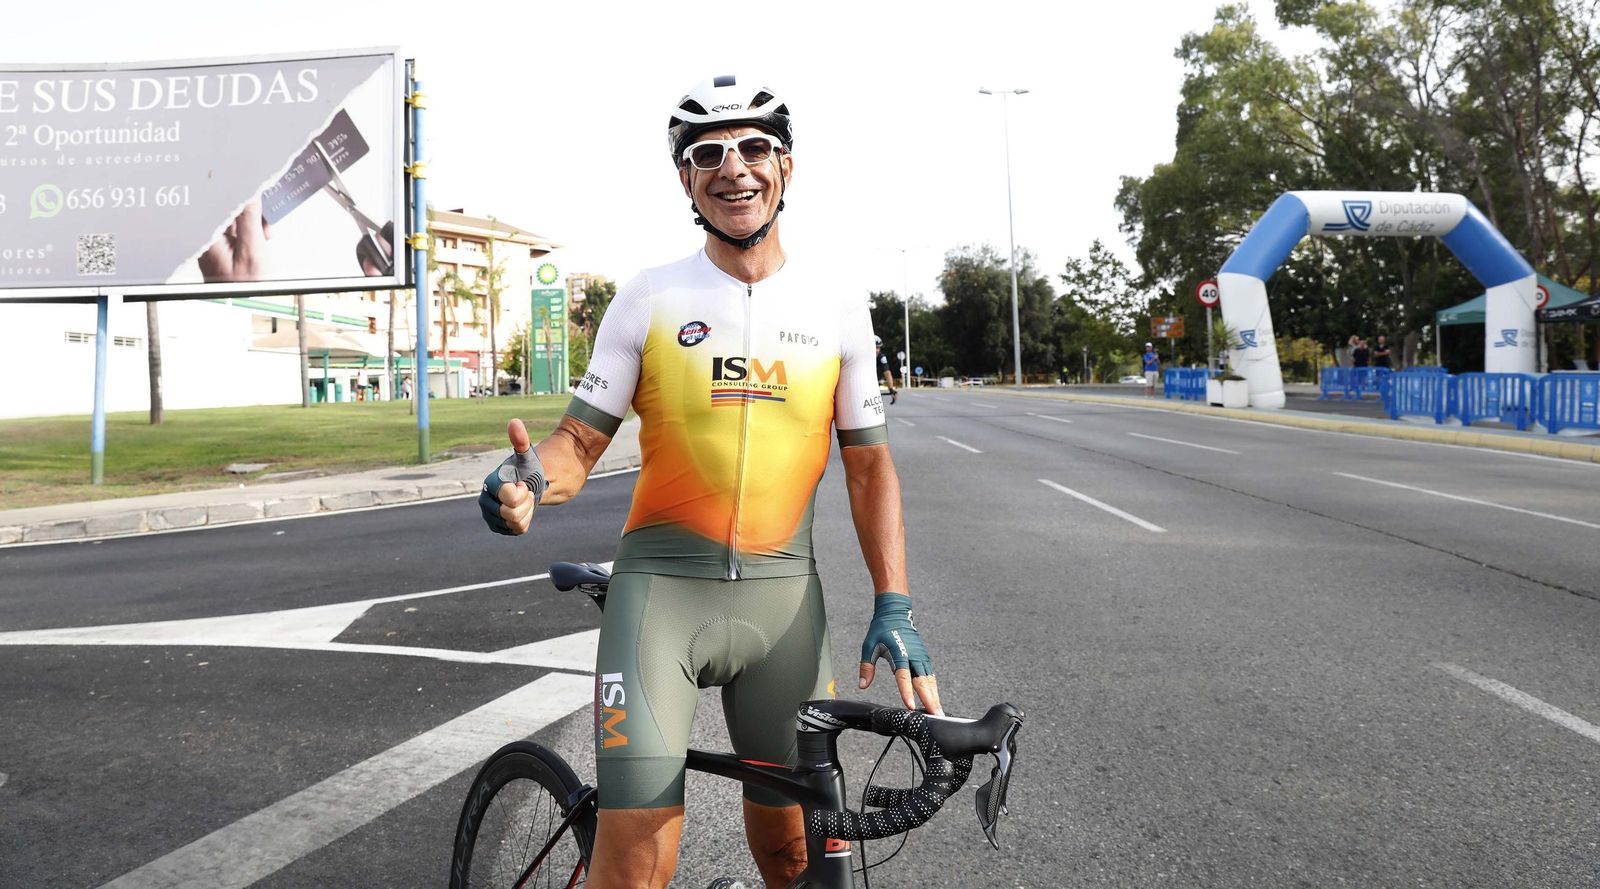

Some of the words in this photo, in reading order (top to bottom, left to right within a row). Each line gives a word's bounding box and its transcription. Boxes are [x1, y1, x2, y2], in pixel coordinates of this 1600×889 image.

[32, 78, 117, 113] SUS
[128, 68, 319, 111] DEUDAS
[5, 124, 27, 146] 2ª
[33, 120, 181, 150] Oportunidad
[57, 154, 75, 166] de
[86, 152, 181, 165] acreedores
[66, 188, 104, 209] 656
[110, 187, 147, 208] 931
[156, 185, 190, 206] 661
[1379, 200, 1450, 216] Diputación
[1375, 221, 1392, 232] de
[1397, 220, 1434, 232] Cádiz
[1202, 289, 1217, 298] 40
[712, 357, 788, 385] ISM
[581, 380, 593, 393] AM
[584, 371, 609, 390] ORES
[711, 381, 758, 389] CONSULTING
[873, 405, 884, 415] TE
[602, 672, 628, 749] ISM
